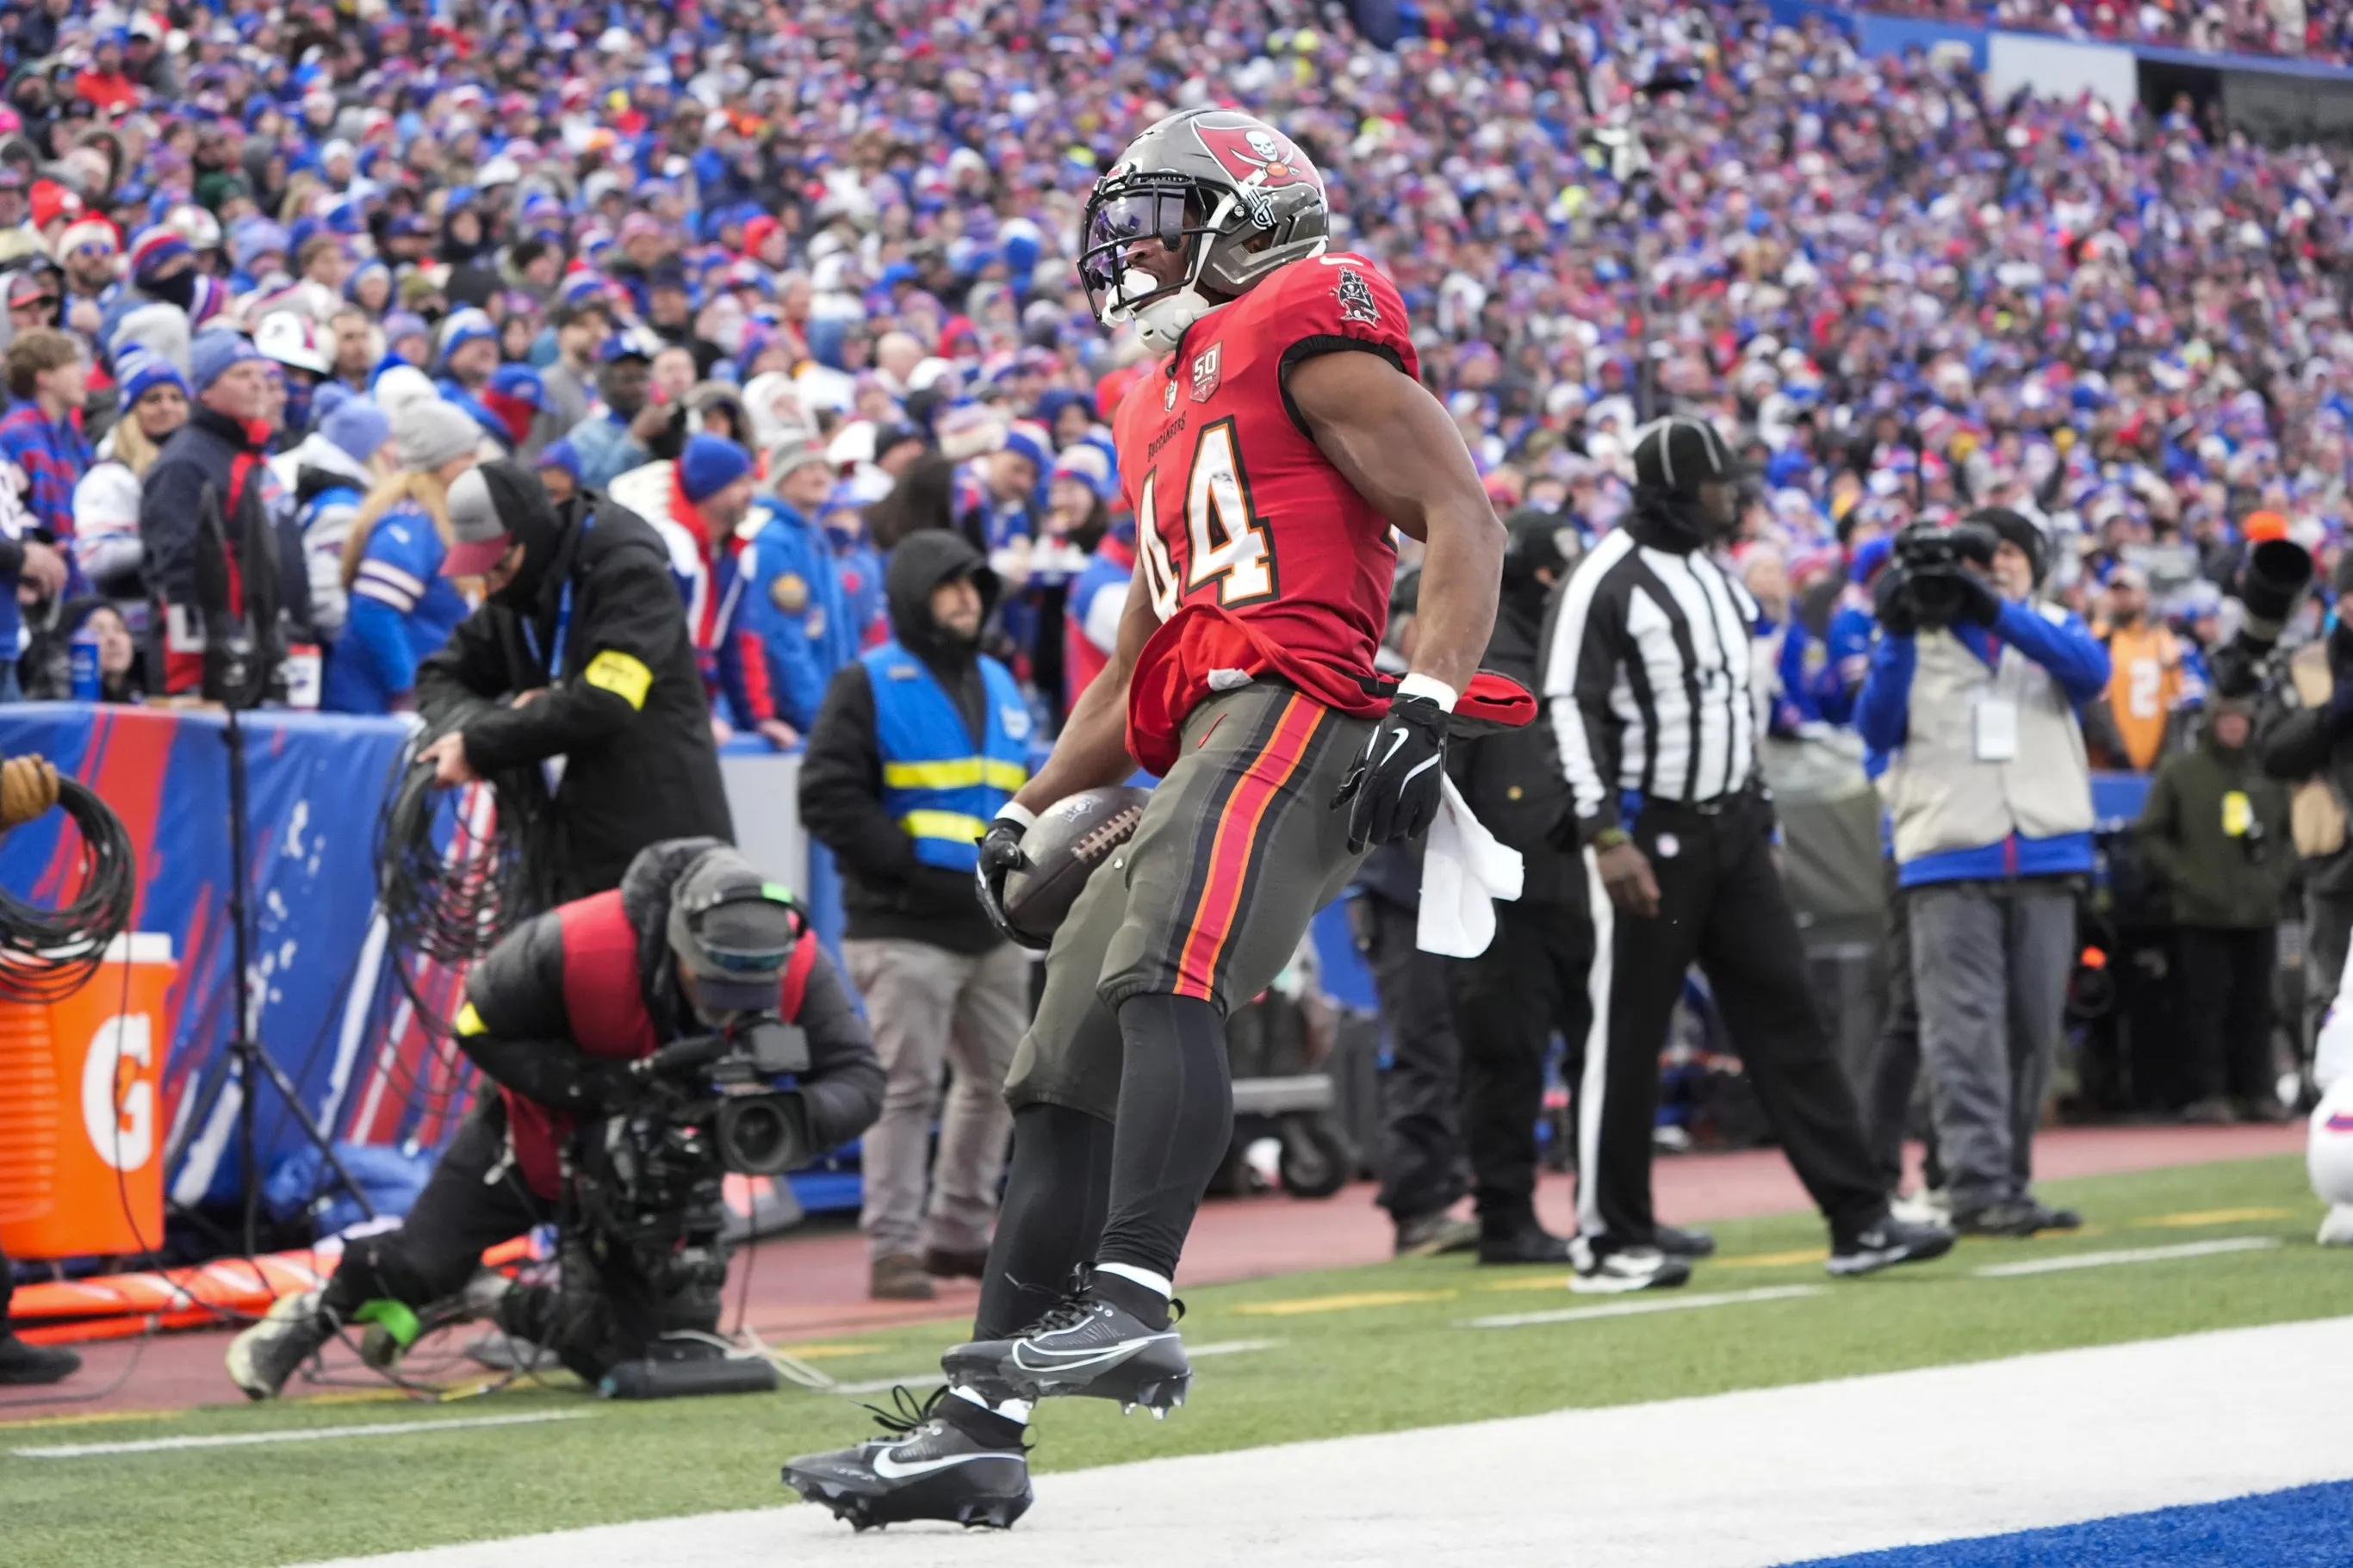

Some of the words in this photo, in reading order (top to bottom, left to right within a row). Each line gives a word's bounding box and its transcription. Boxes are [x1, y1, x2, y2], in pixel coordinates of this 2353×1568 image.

[1193, 348, 1217, 382] 50
[1147, 410, 1187, 462] BUCCANEERS
[1139, 412, 1281, 623] 44
[2130, 658, 2160, 720] 2
[82, 1012, 152, 1172] G
